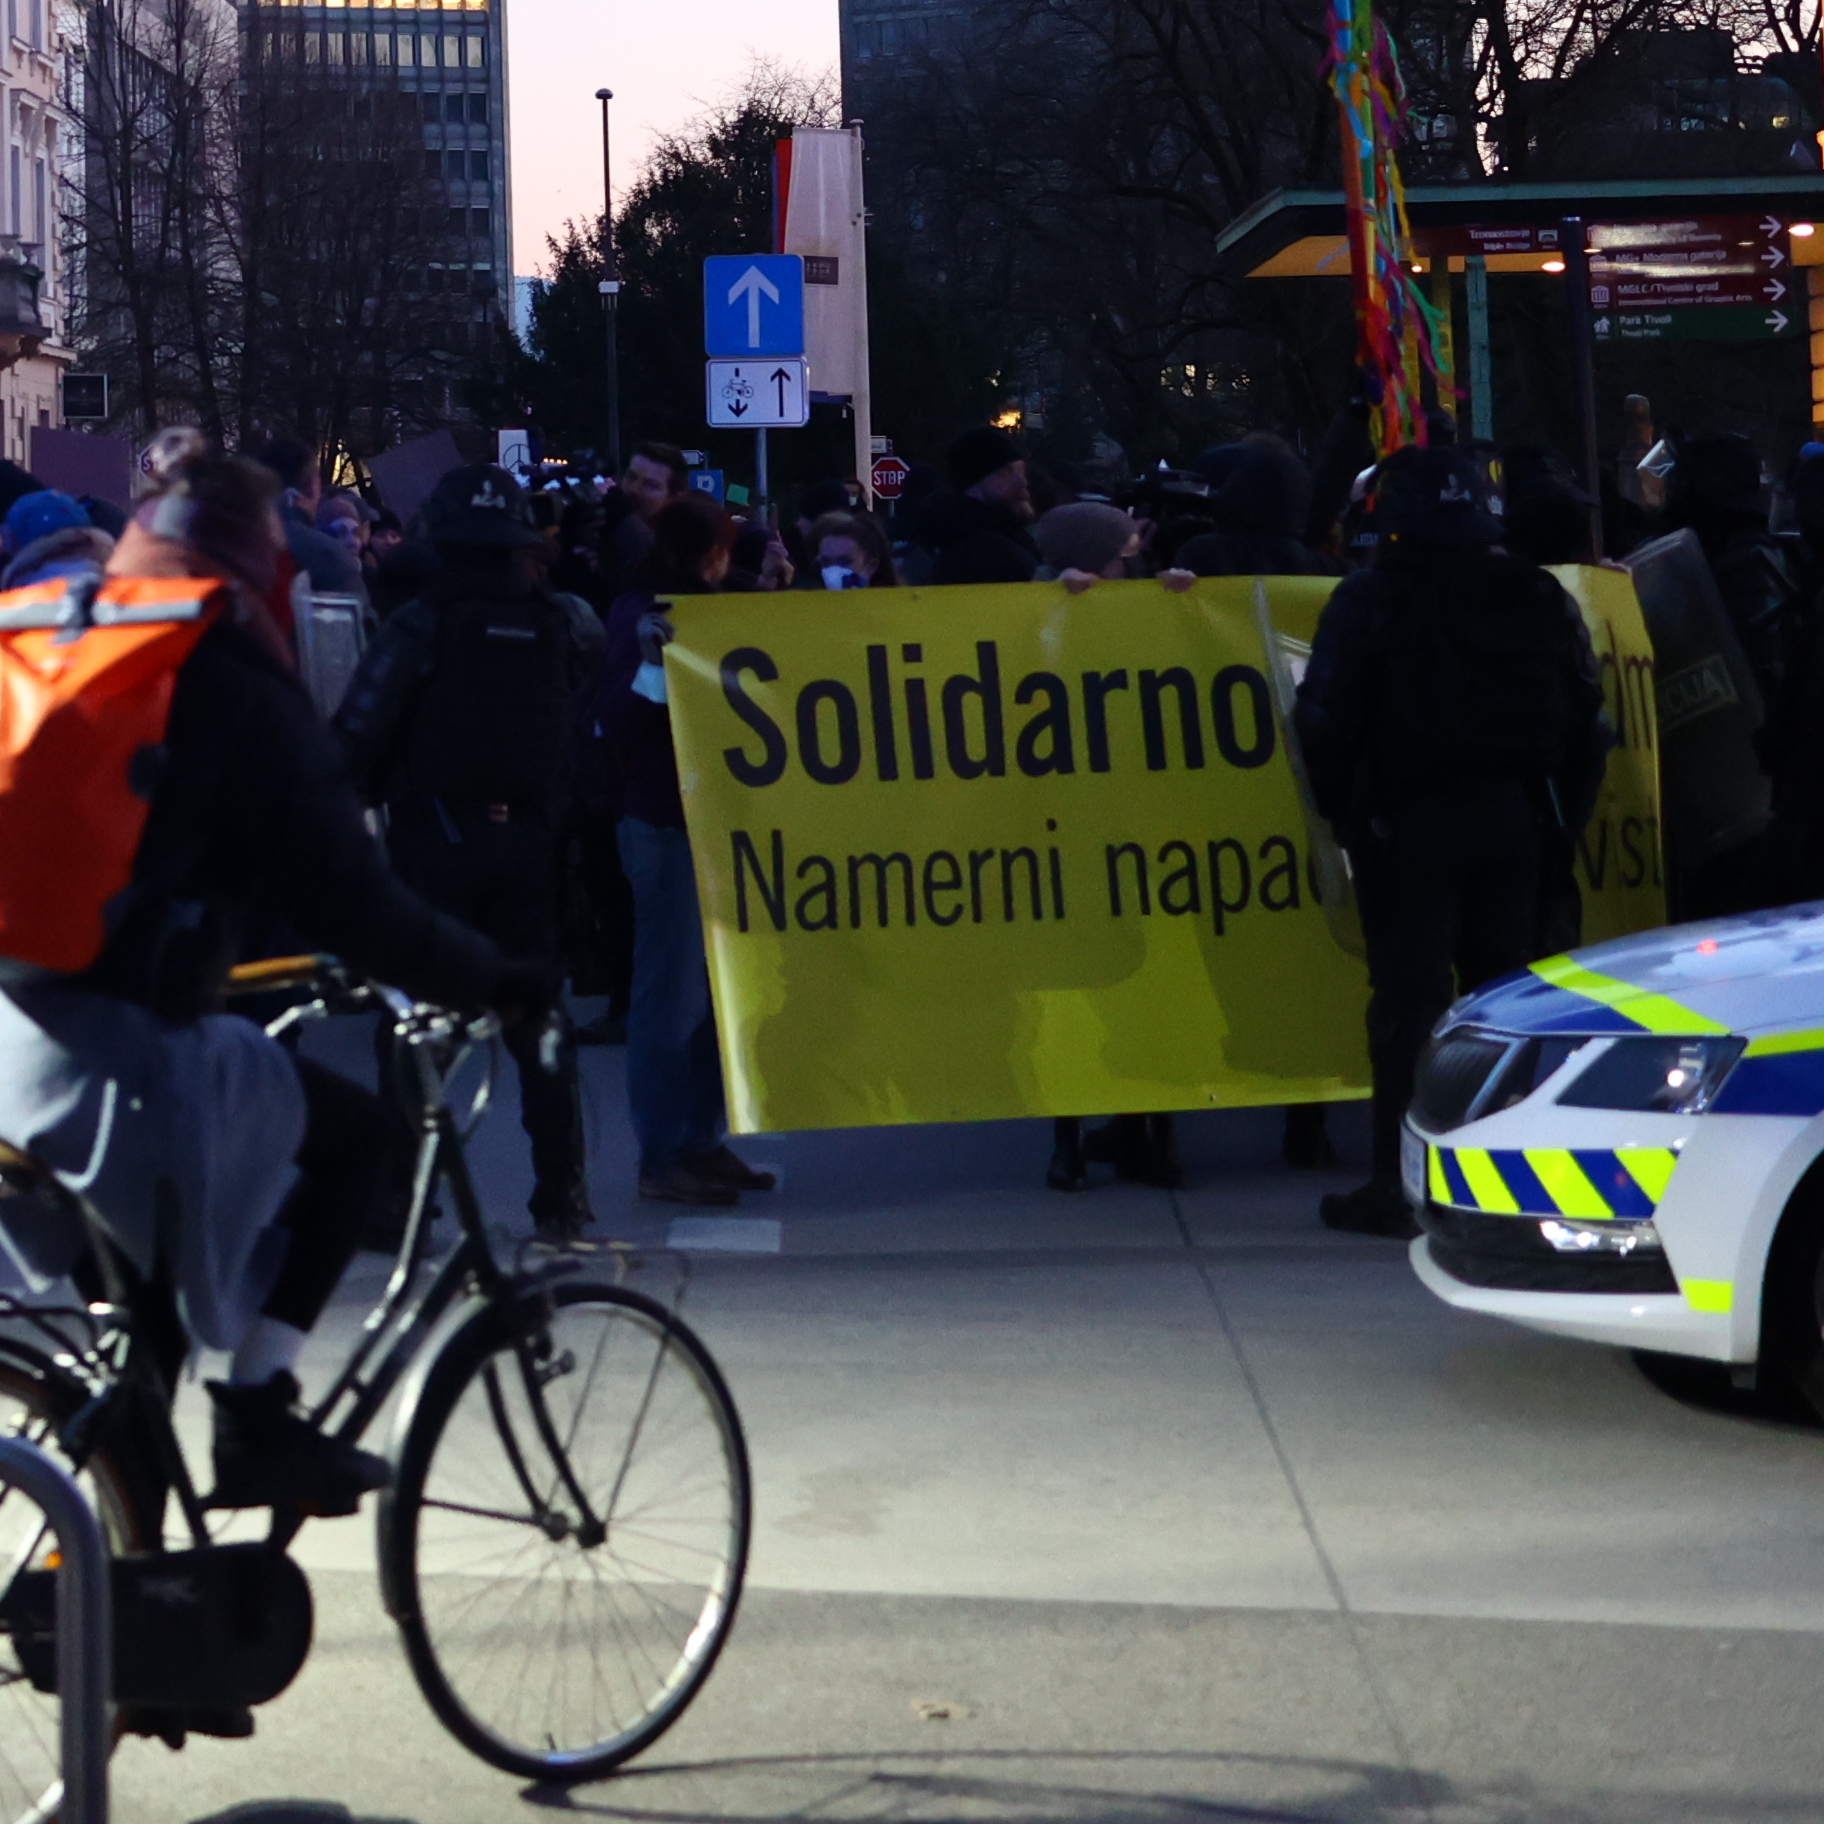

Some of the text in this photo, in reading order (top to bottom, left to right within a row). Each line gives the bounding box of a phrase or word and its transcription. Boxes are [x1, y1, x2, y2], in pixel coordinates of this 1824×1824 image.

[1619, 315, 1642, 325] Park
[873, 470, 906, 486] STOP
[730, 819, 1065, 933] Namerni
